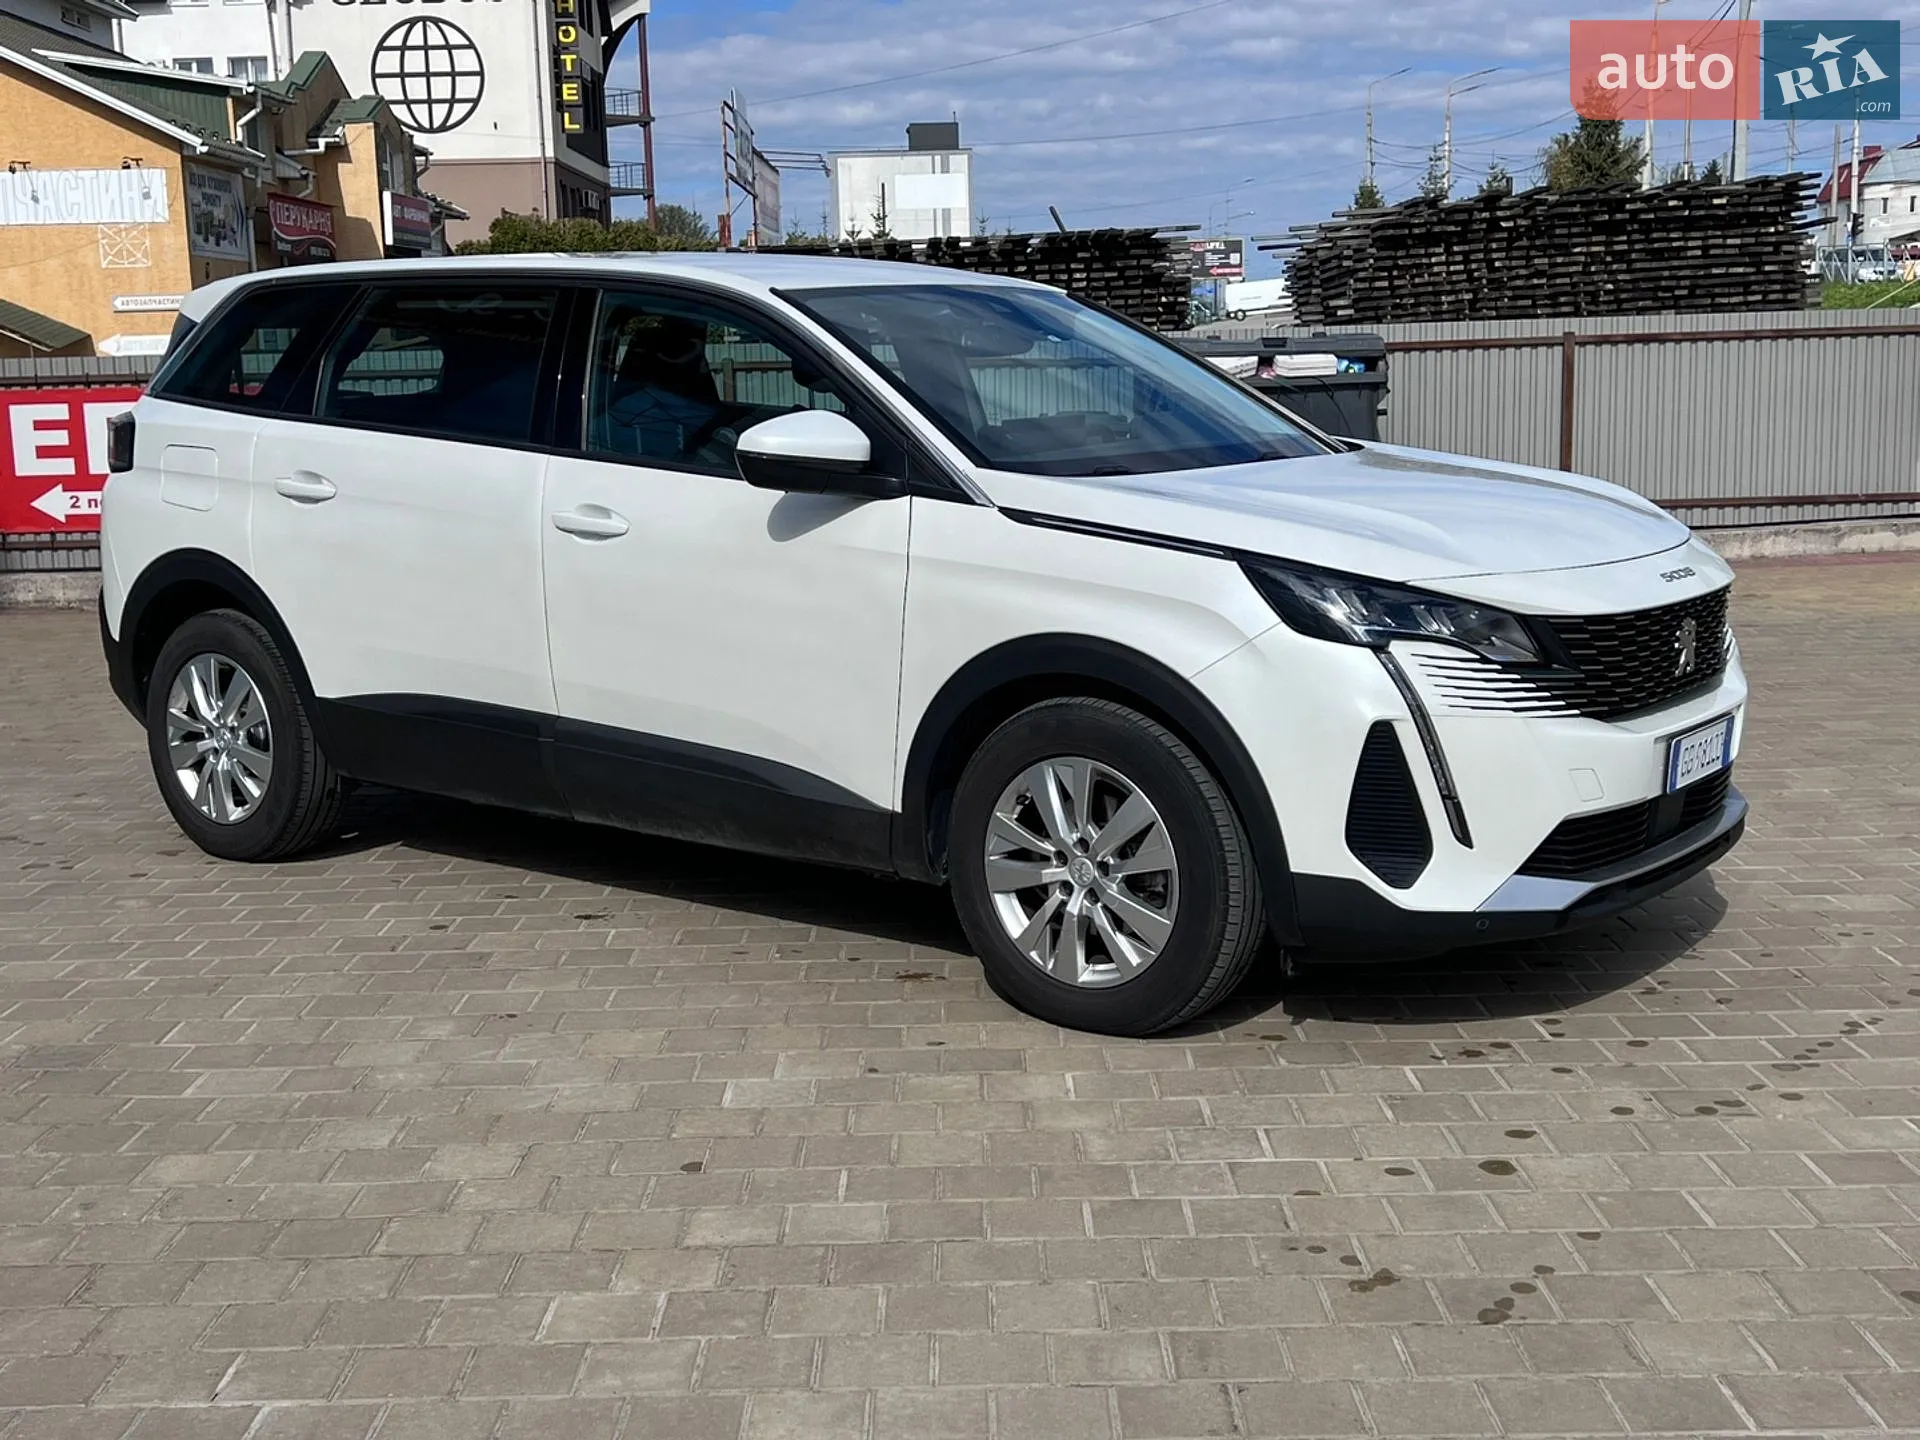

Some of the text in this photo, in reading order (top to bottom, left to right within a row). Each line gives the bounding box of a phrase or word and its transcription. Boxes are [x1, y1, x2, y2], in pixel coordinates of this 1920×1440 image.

[557, 0, 581, 130] HOTEL
[275, 202, 332, 235] ПЕРУКАРНЯ
[121, 298, 182, 307] АВТОЗАПЧАСТИН
[69, 495, 81, 508] 2
[1659, 566, 1696, 583] 5008
